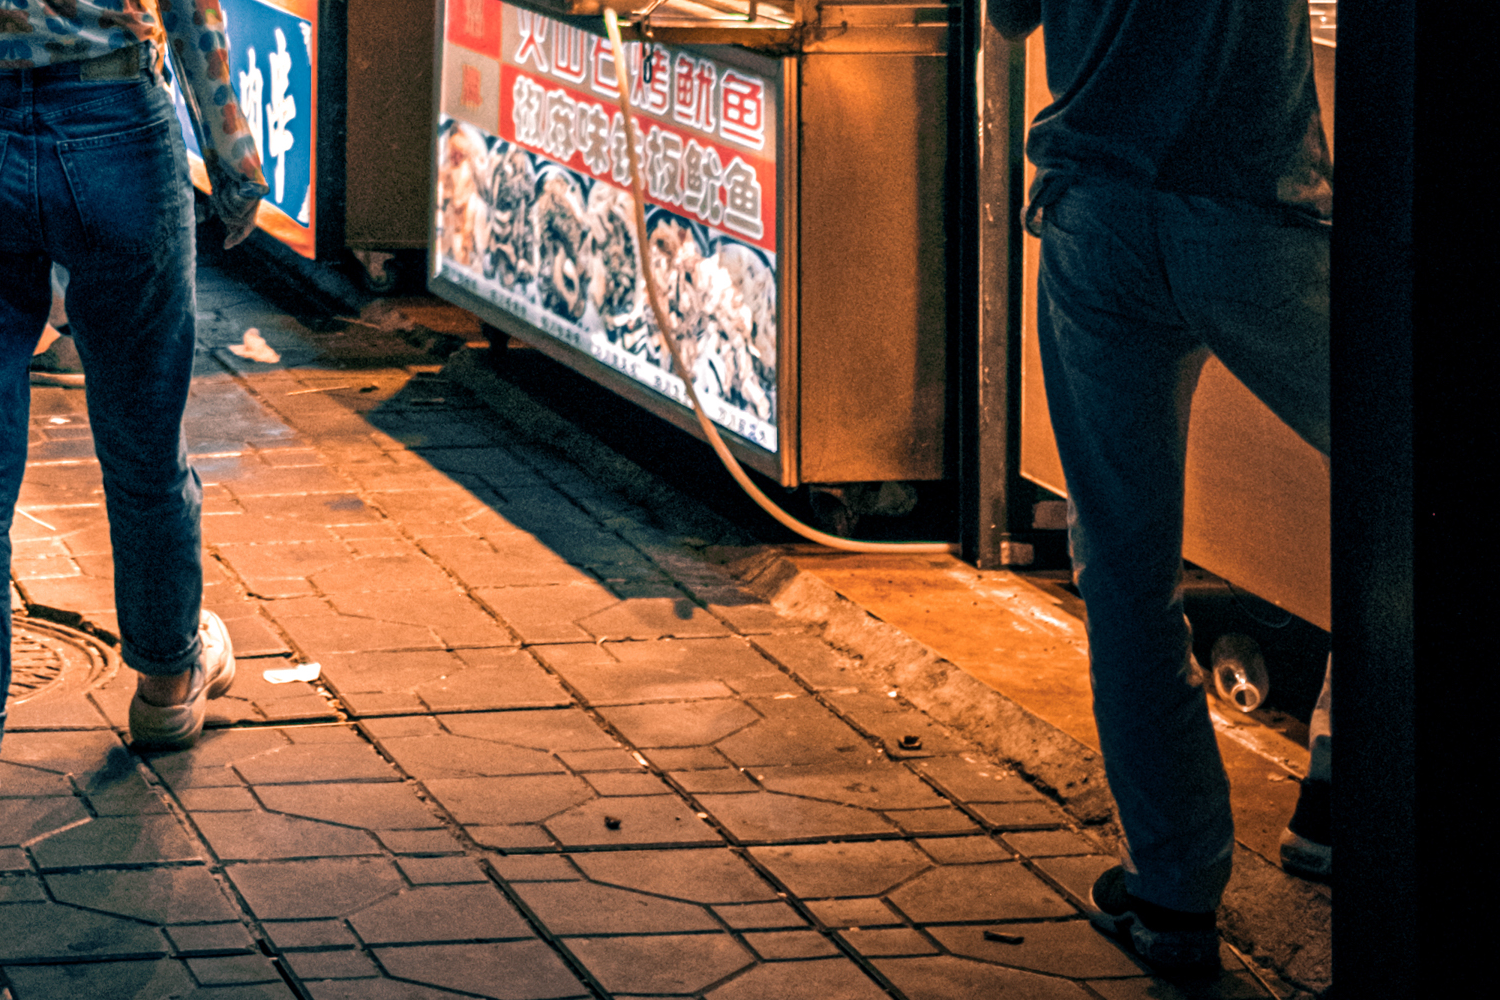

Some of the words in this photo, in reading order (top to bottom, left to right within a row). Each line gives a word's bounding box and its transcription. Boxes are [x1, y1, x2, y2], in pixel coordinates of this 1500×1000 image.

[513, 5, 766, 151] 火山石烤鱿鱼
